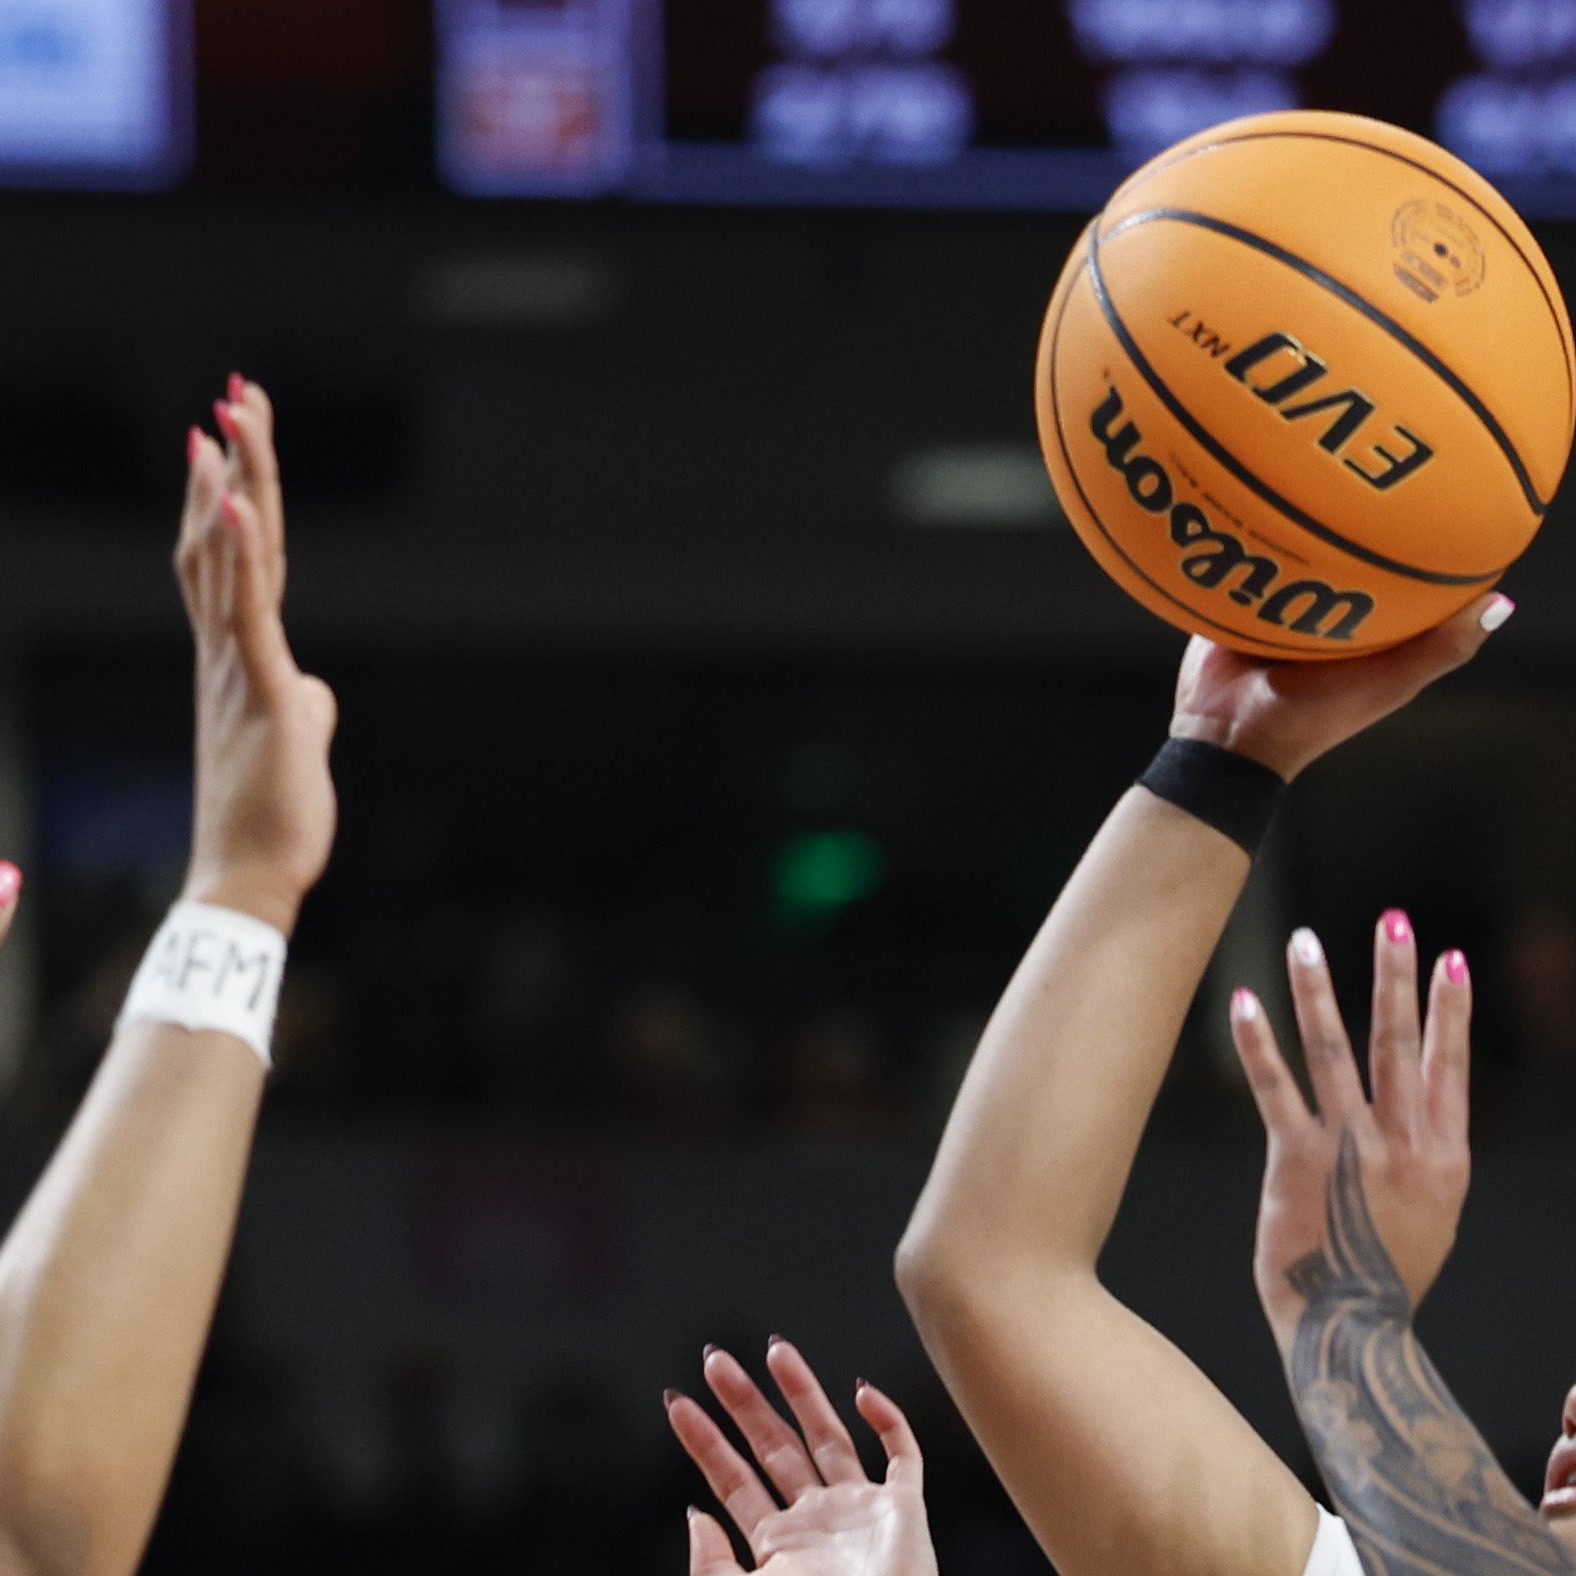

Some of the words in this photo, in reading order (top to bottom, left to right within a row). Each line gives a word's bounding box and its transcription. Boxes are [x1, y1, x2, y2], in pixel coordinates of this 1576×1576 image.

[1167, 311, 1229, 359] NXT
[1224, 330, 1435, 492] EVO
[1090, 384, 1375, 640] Wilson
